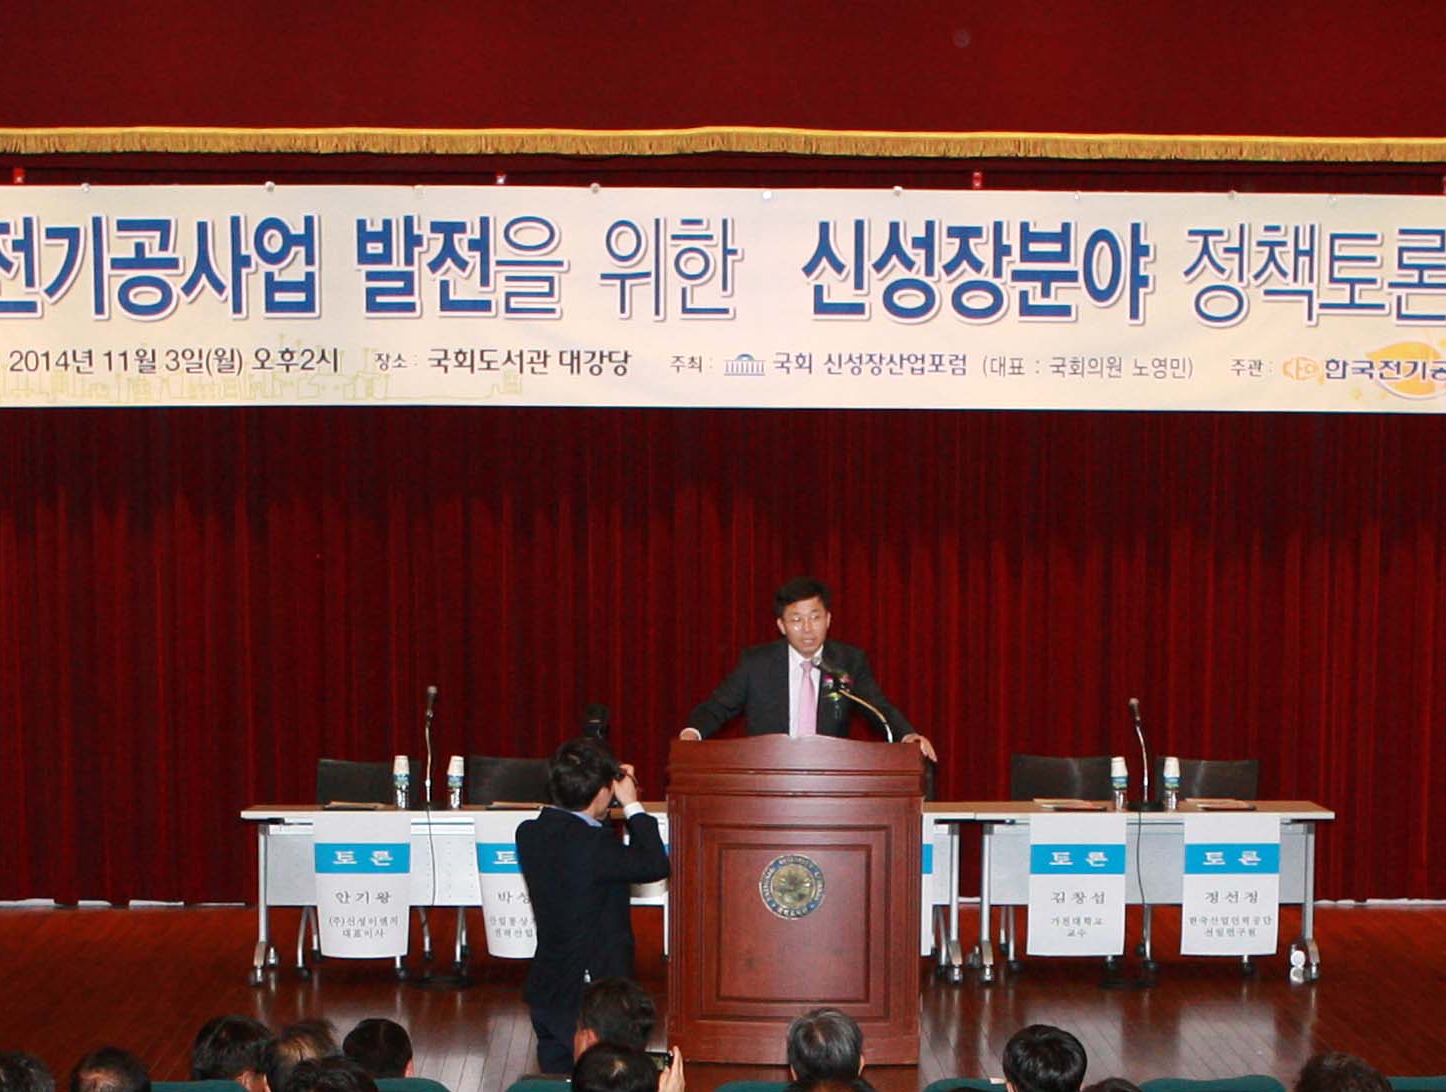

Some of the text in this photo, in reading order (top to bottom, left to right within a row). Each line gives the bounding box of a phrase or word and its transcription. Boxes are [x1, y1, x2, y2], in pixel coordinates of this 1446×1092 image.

[354, 213, 569, 317] 발전을
[599, 215, 740, 317] 위한
[800, 216, 1151, 322] 신성장분야
[9, 348, 96, 375] 2014년
[103, 348, 157, 375] 11월
[164, 347, 244, 377] 3일(월)
[251, 346, 340, 375] 오후2시
[428, 347, 551, 376] 국회도서관
[558, 348, 633, 377] 대강당
[772, 351, 814, 376] 국회
[823, 351, 968, 377] 신성장산업포럼
[981, 354, 1026, 378] (대표
[1050, 355, 1124, 379] 국회의원
[1131, 356, 1195, 380] 노영민)
